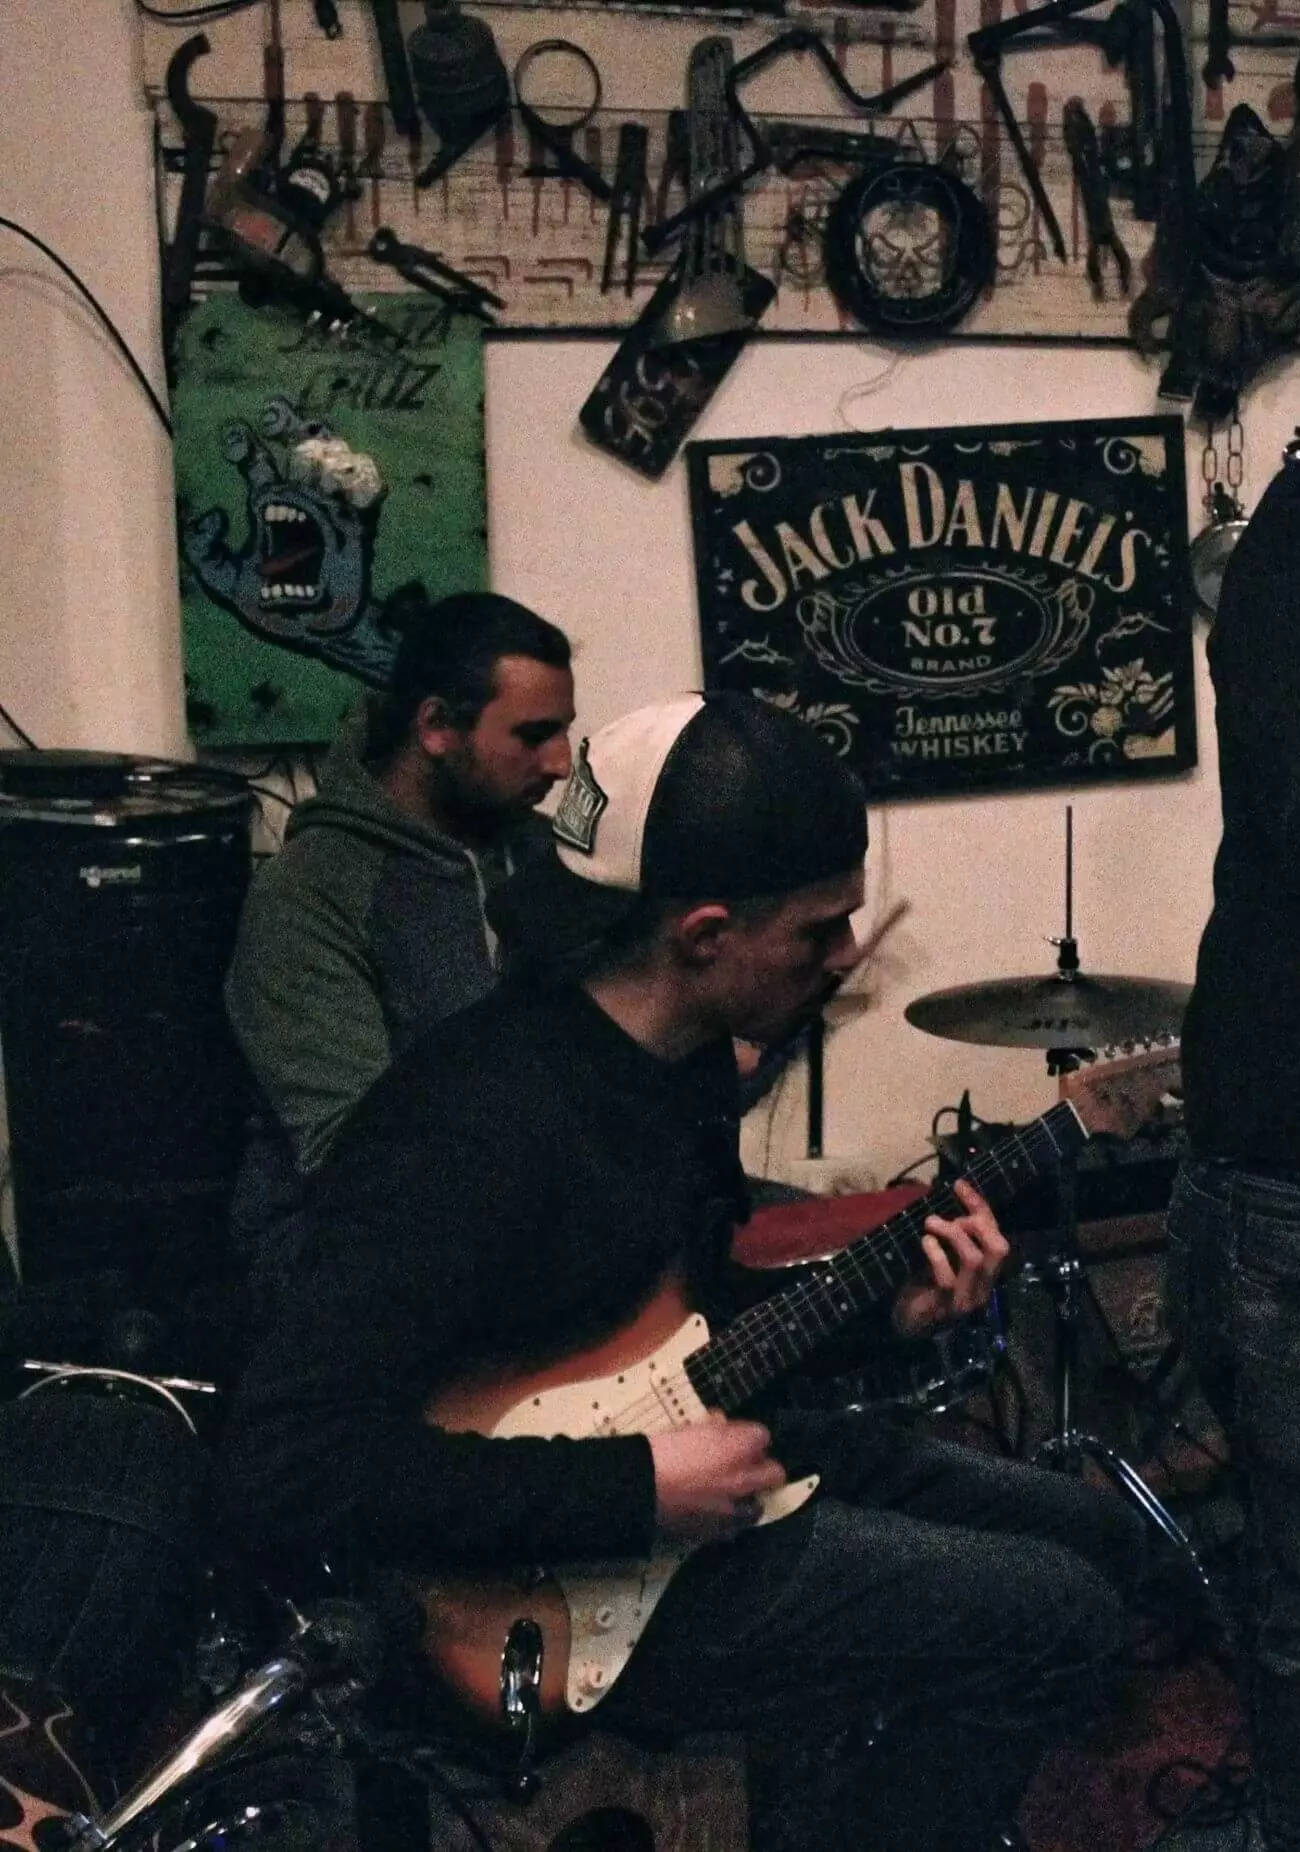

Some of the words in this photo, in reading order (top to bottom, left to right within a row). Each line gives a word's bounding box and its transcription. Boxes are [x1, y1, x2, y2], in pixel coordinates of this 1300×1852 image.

[732, 488, 896, 612] JACK
[900, 461, 1152, 593] DANIEL'S
[907, 585, 986, 617] Old
[910, 654, 993, 672] BRAND
[894, 705, 1023, 738] Tennessee
[891, 731, 1028, 761] WHISKEY
